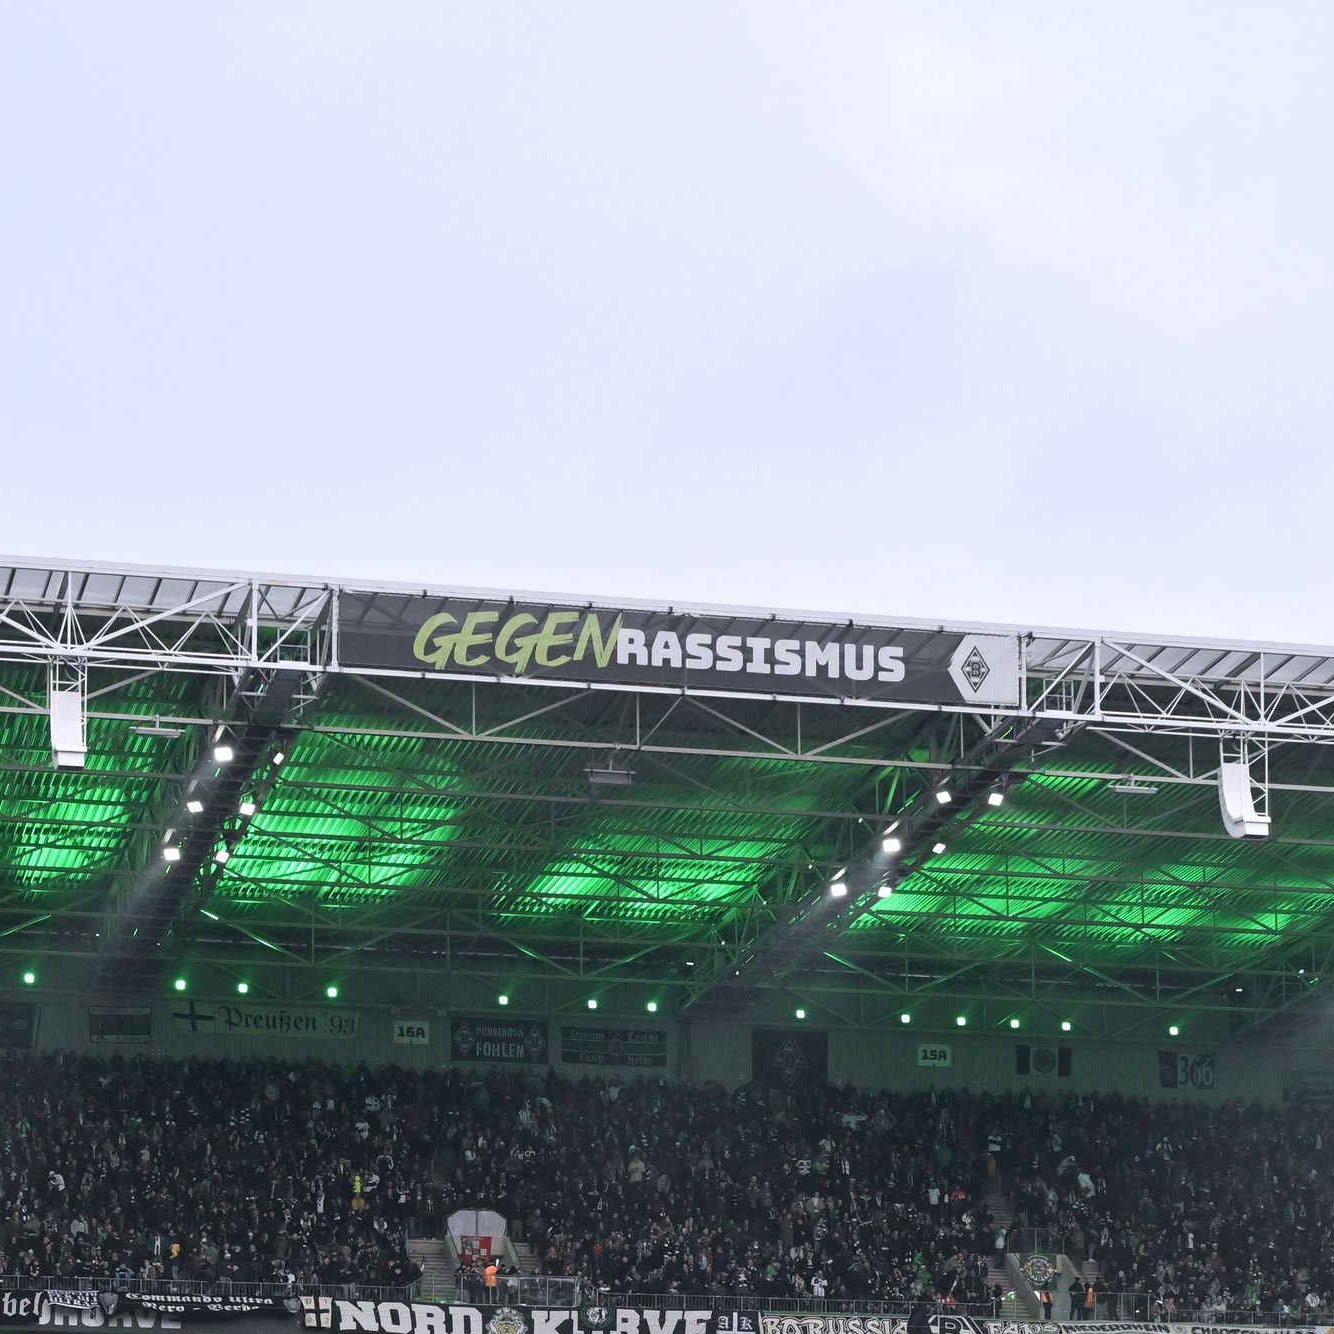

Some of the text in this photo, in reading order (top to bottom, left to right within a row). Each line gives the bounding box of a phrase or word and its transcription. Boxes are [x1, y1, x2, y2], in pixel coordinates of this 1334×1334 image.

[216, 1005, 316, 1033] Preußen
[397, 1027, 426, 1039] 16A
[475, 1041, 524, 1059] FOHLEN
[921, 1050, 948, 1062] 15A
[1063, 1322, 1170, 1334] NIEDERRHEIN
